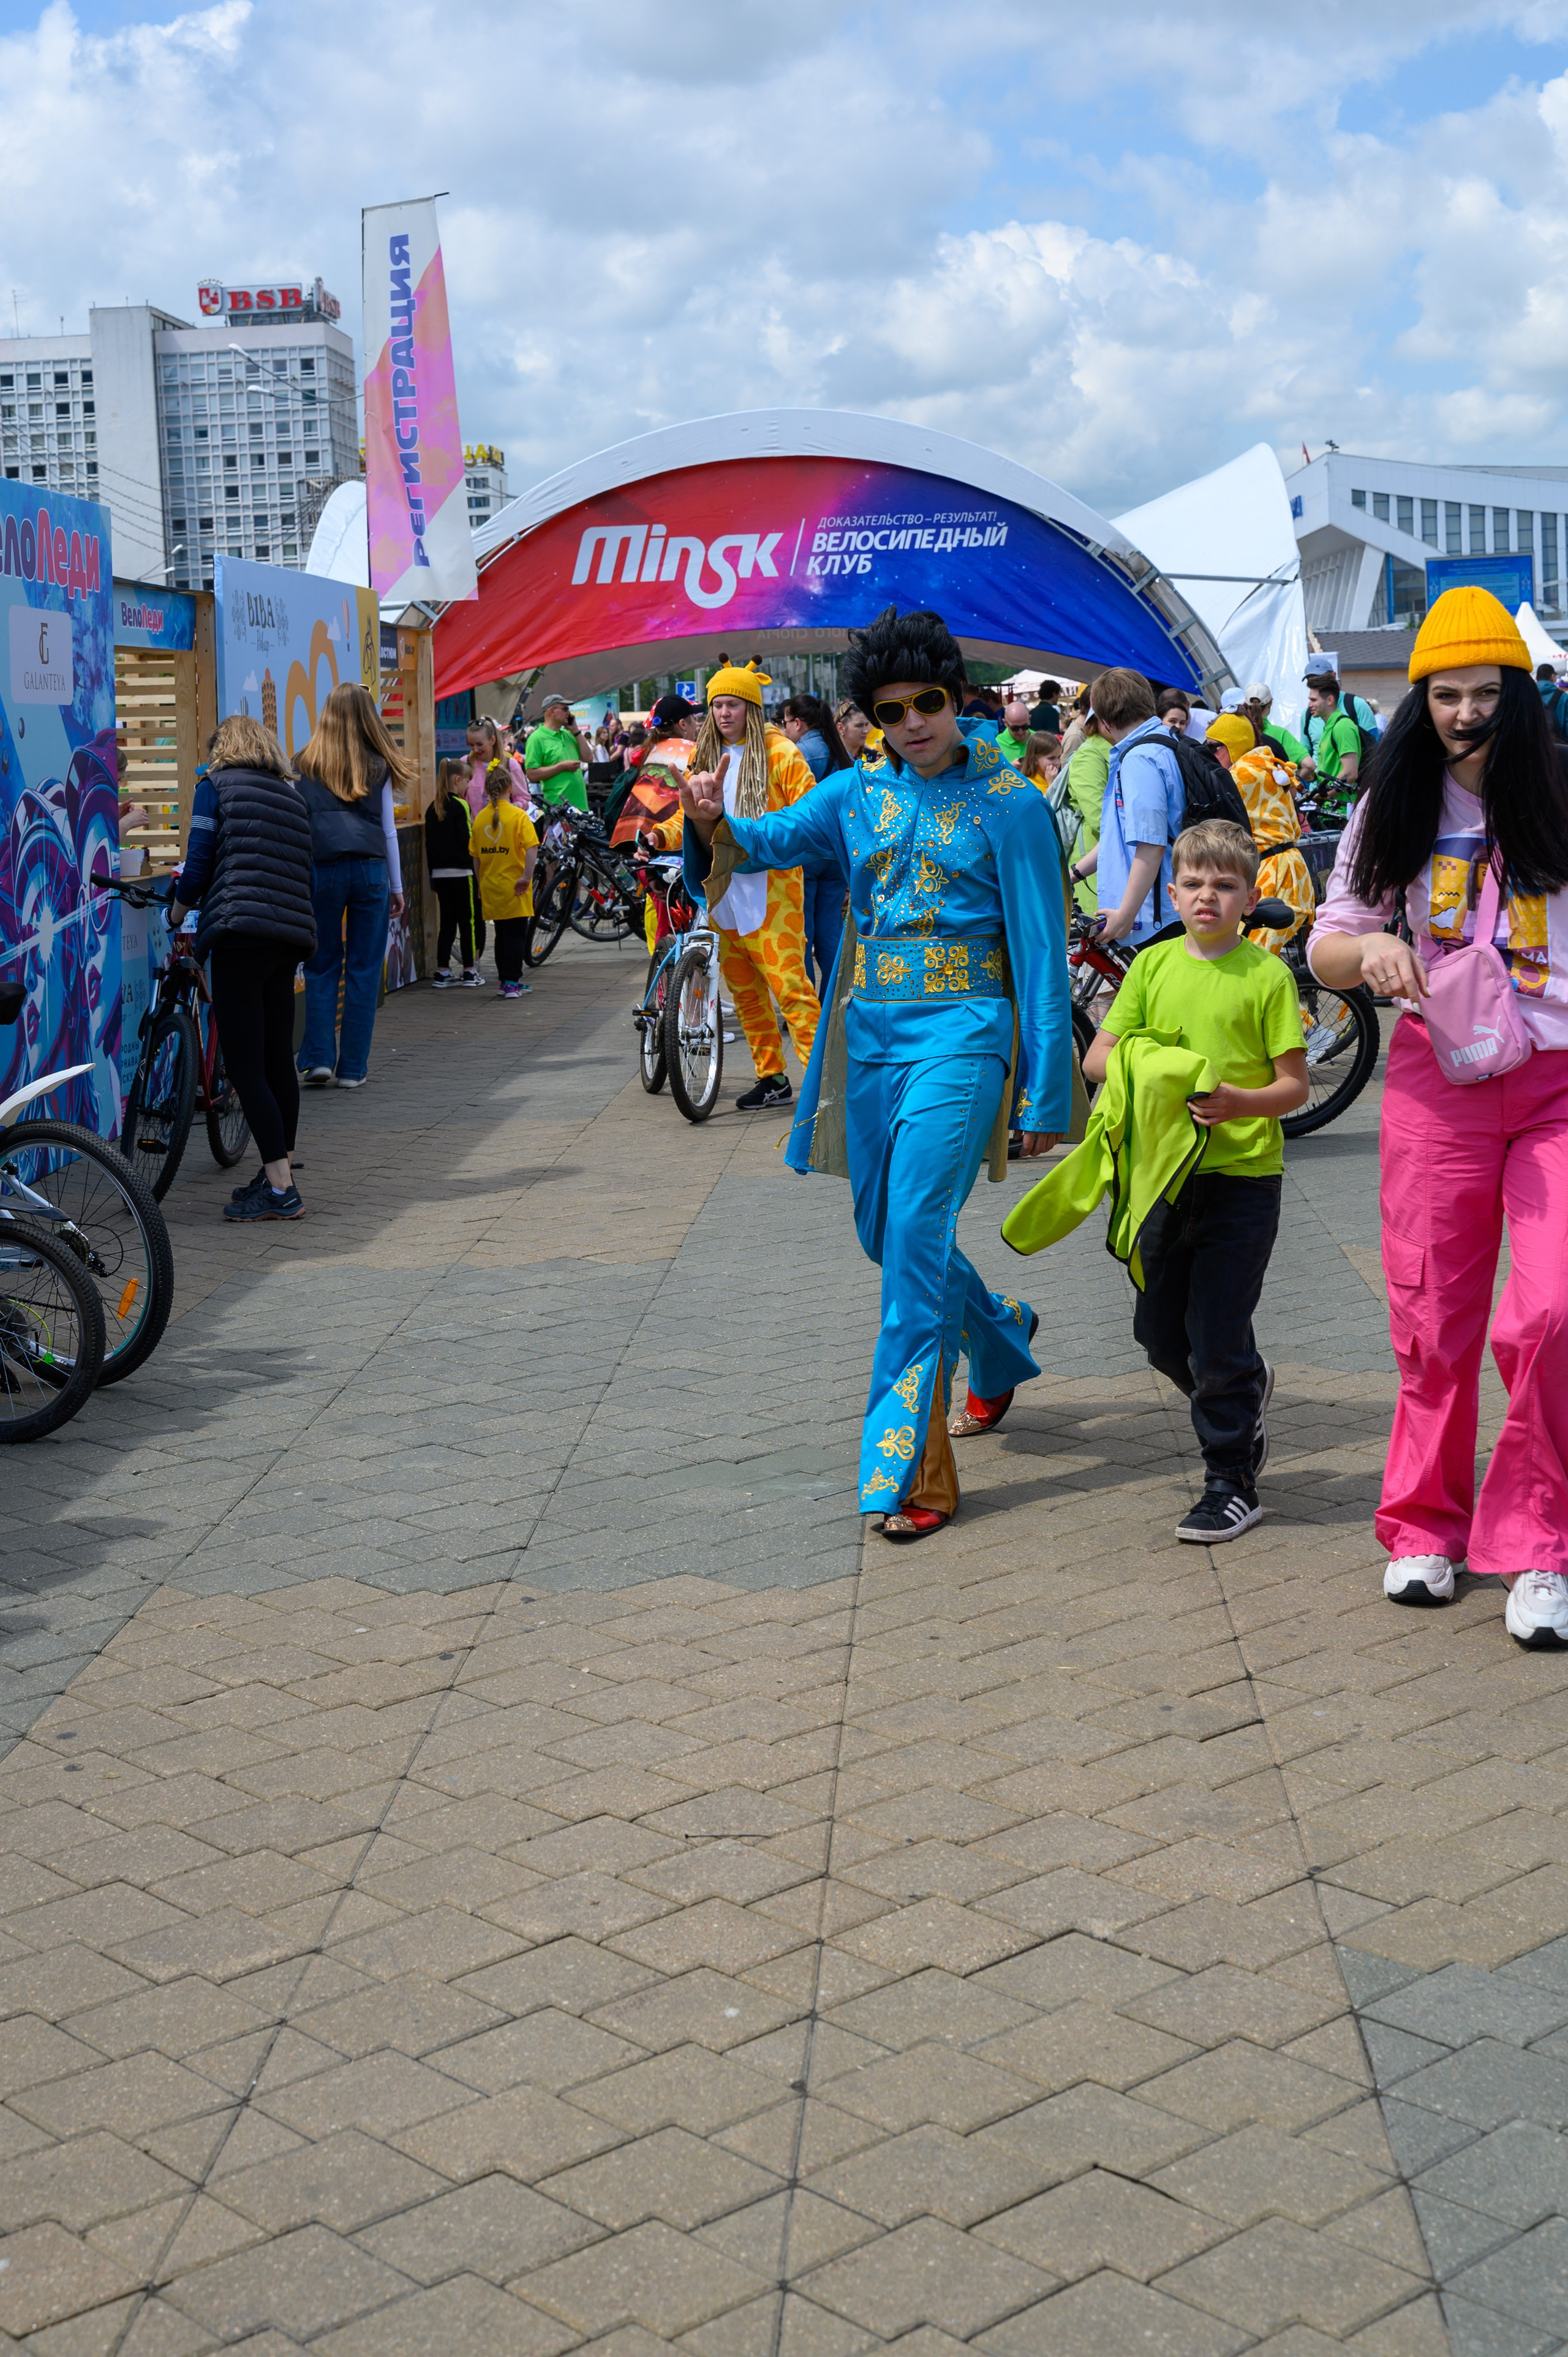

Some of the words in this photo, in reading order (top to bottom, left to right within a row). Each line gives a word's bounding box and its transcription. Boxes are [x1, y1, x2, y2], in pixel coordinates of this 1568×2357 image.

[227, 288, 303, 311] BSB
[389, 233, 430, 567] РЕГИСТРАЦИЯ
[817, 513, 923, 529] ДОКАЗАТЕЛЬСТВО
[933, 511, 997, 523] РЕЗУЛЬТАТ!
[812, 522, 1008, 552] ВЕЛОСИПЕДНЫЙ
[0, 508, 100, 601] лоЛеди
[571, 524, 783, 609] Minsk
[806, 554, 872, 576] КЛУБ
[121, 601, 164, 635] ВелоЛеди
[24, 671, 66, 691] GALANTEYA
[1450, 1037, 1498, 1067] PUMA
